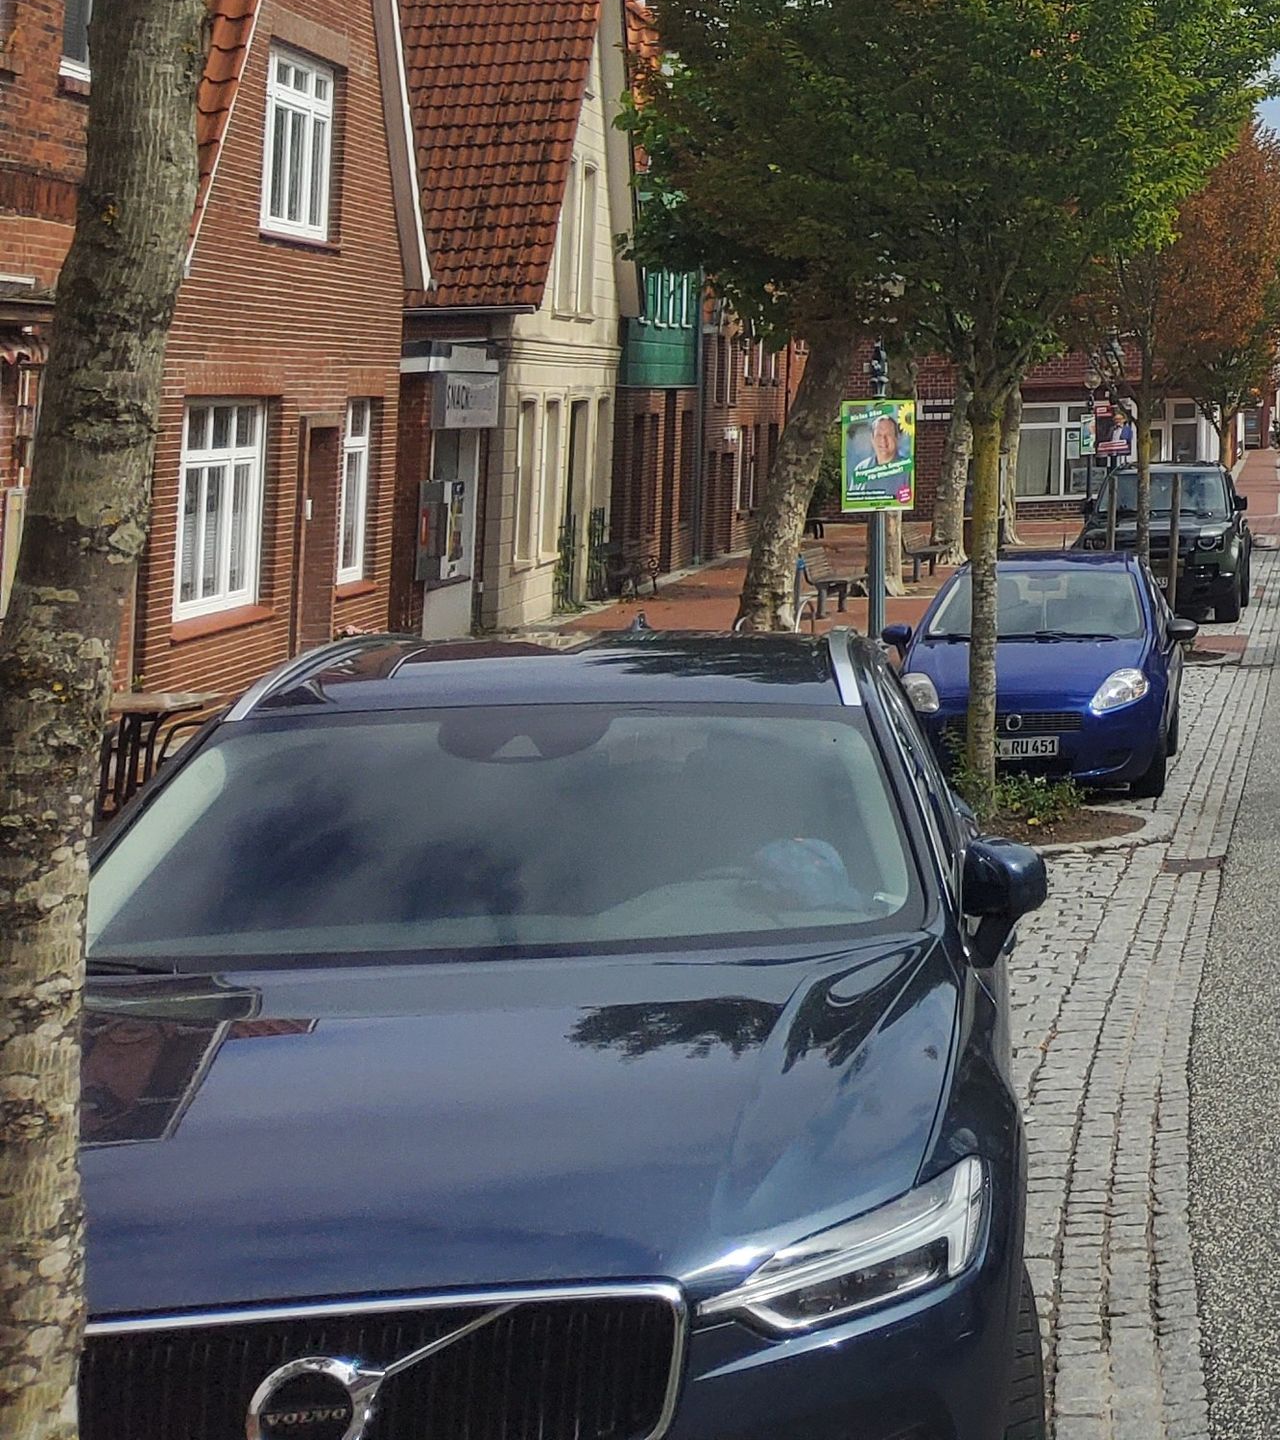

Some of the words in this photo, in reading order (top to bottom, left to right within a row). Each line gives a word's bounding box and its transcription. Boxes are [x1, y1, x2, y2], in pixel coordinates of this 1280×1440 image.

[1011, 740, 1029, 755] RU
[1032, 740, 1056, 754] 451
[266, 1408, 347, 1426] VOLVO
